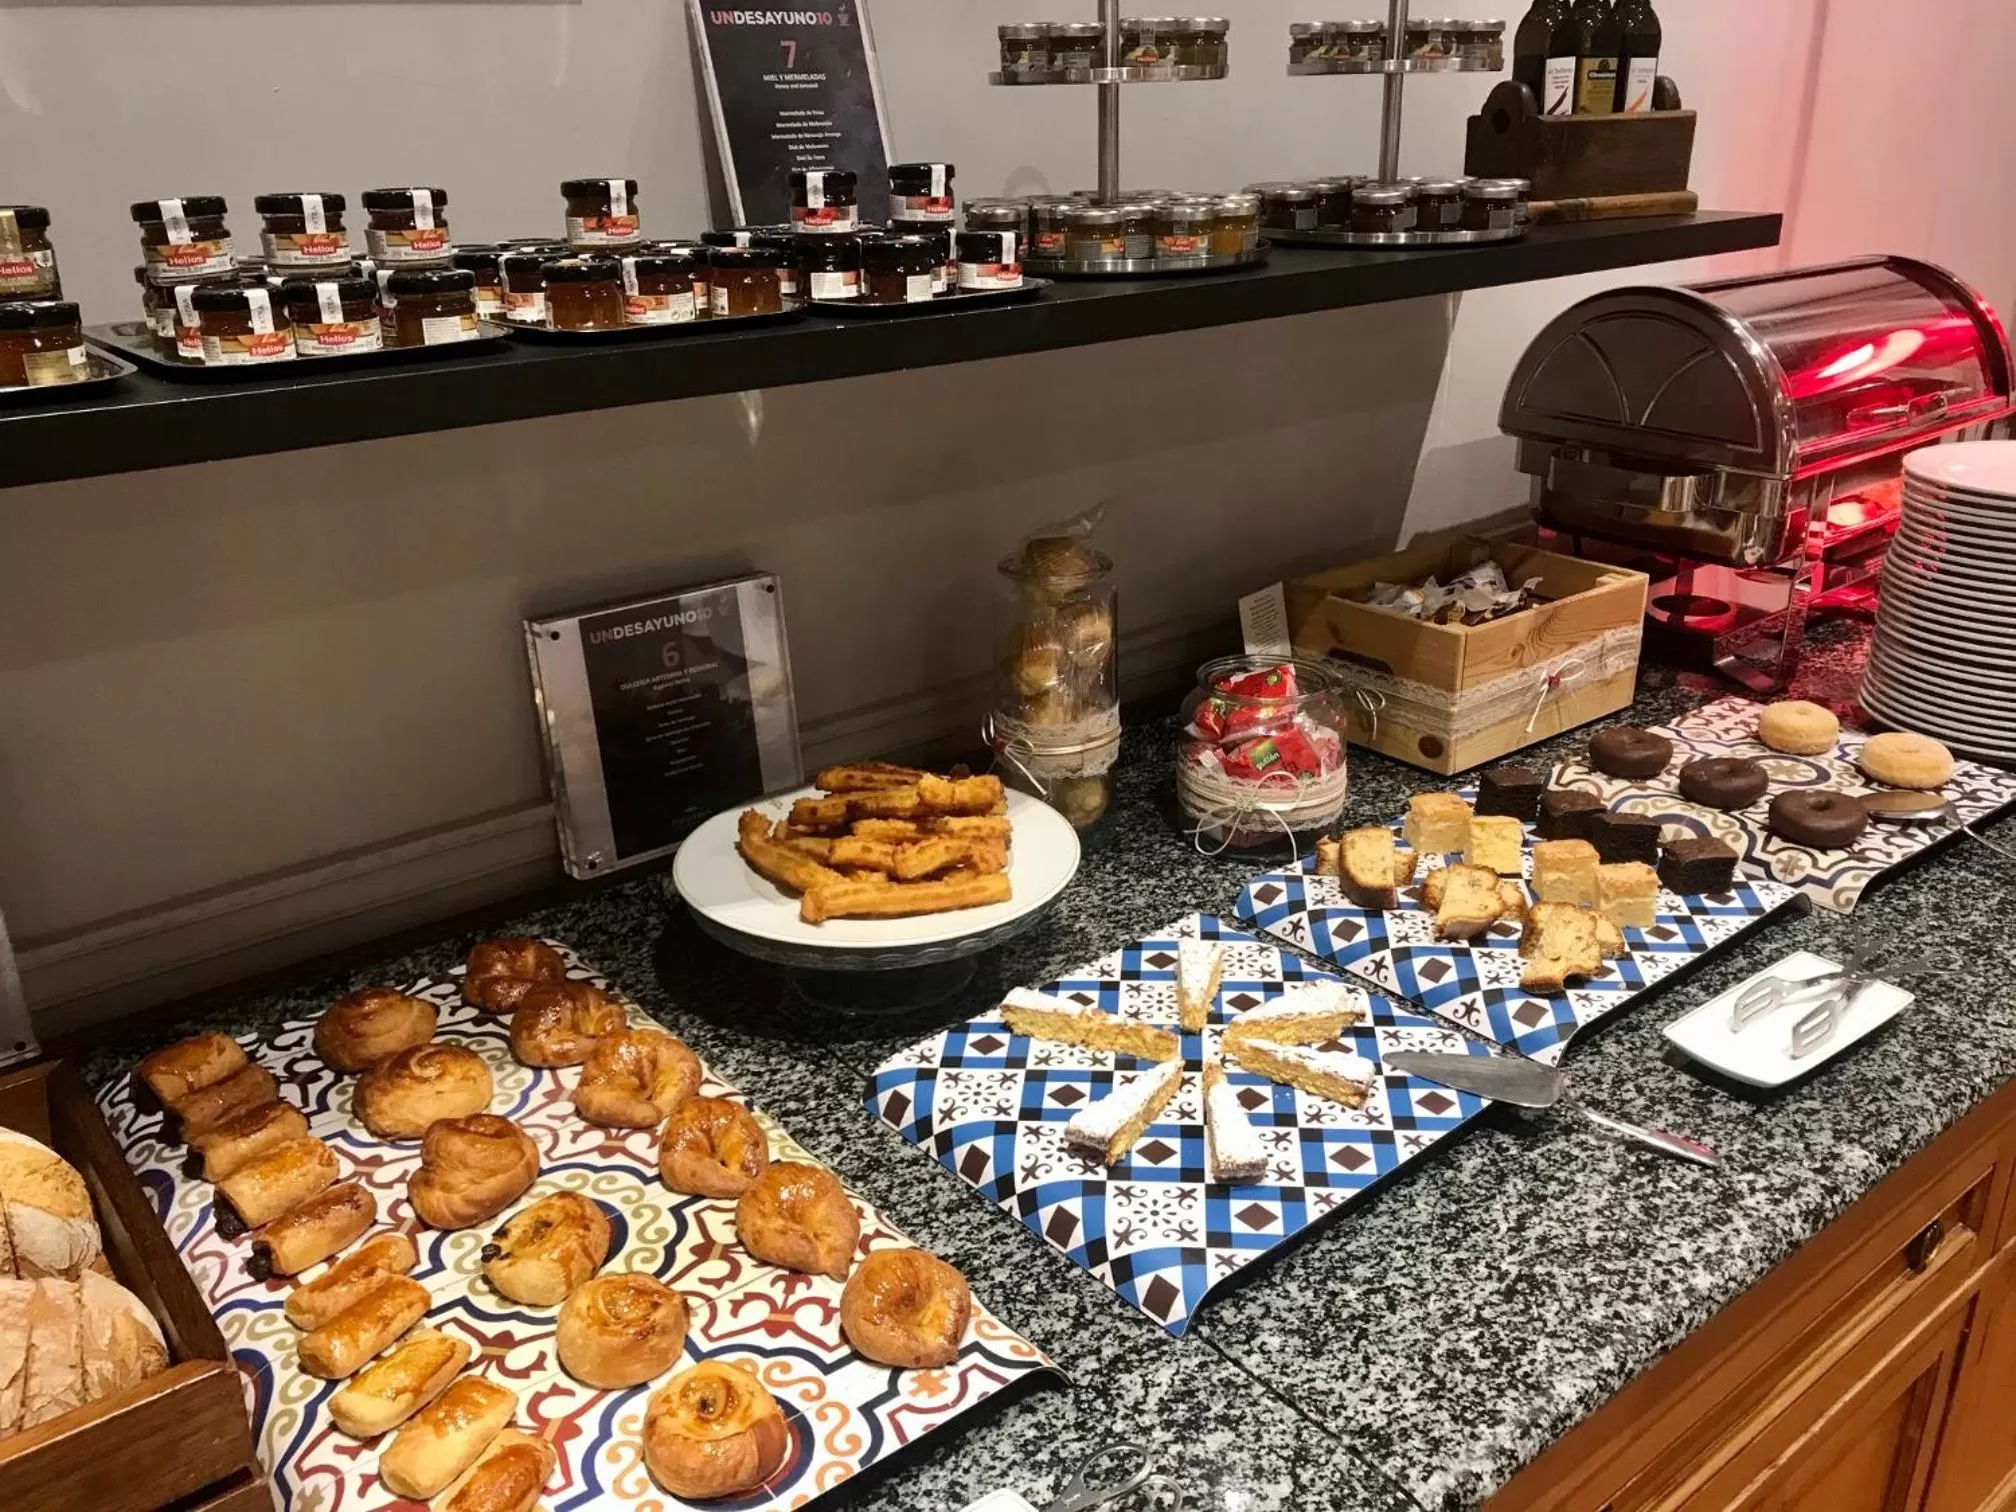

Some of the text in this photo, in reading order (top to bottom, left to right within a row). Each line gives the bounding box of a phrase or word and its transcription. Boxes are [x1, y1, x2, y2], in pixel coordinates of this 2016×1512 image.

[780, 40, 797, 69] 7
[414, 240, 442, 249] Helios
[303, 246, 335, 254] Helios
[169, 256, 204, 266] Helios
[319, 334, 353, 344] Helios
[252, 344, 284, 355] Helios
[661, 641, 681, 668] 6
